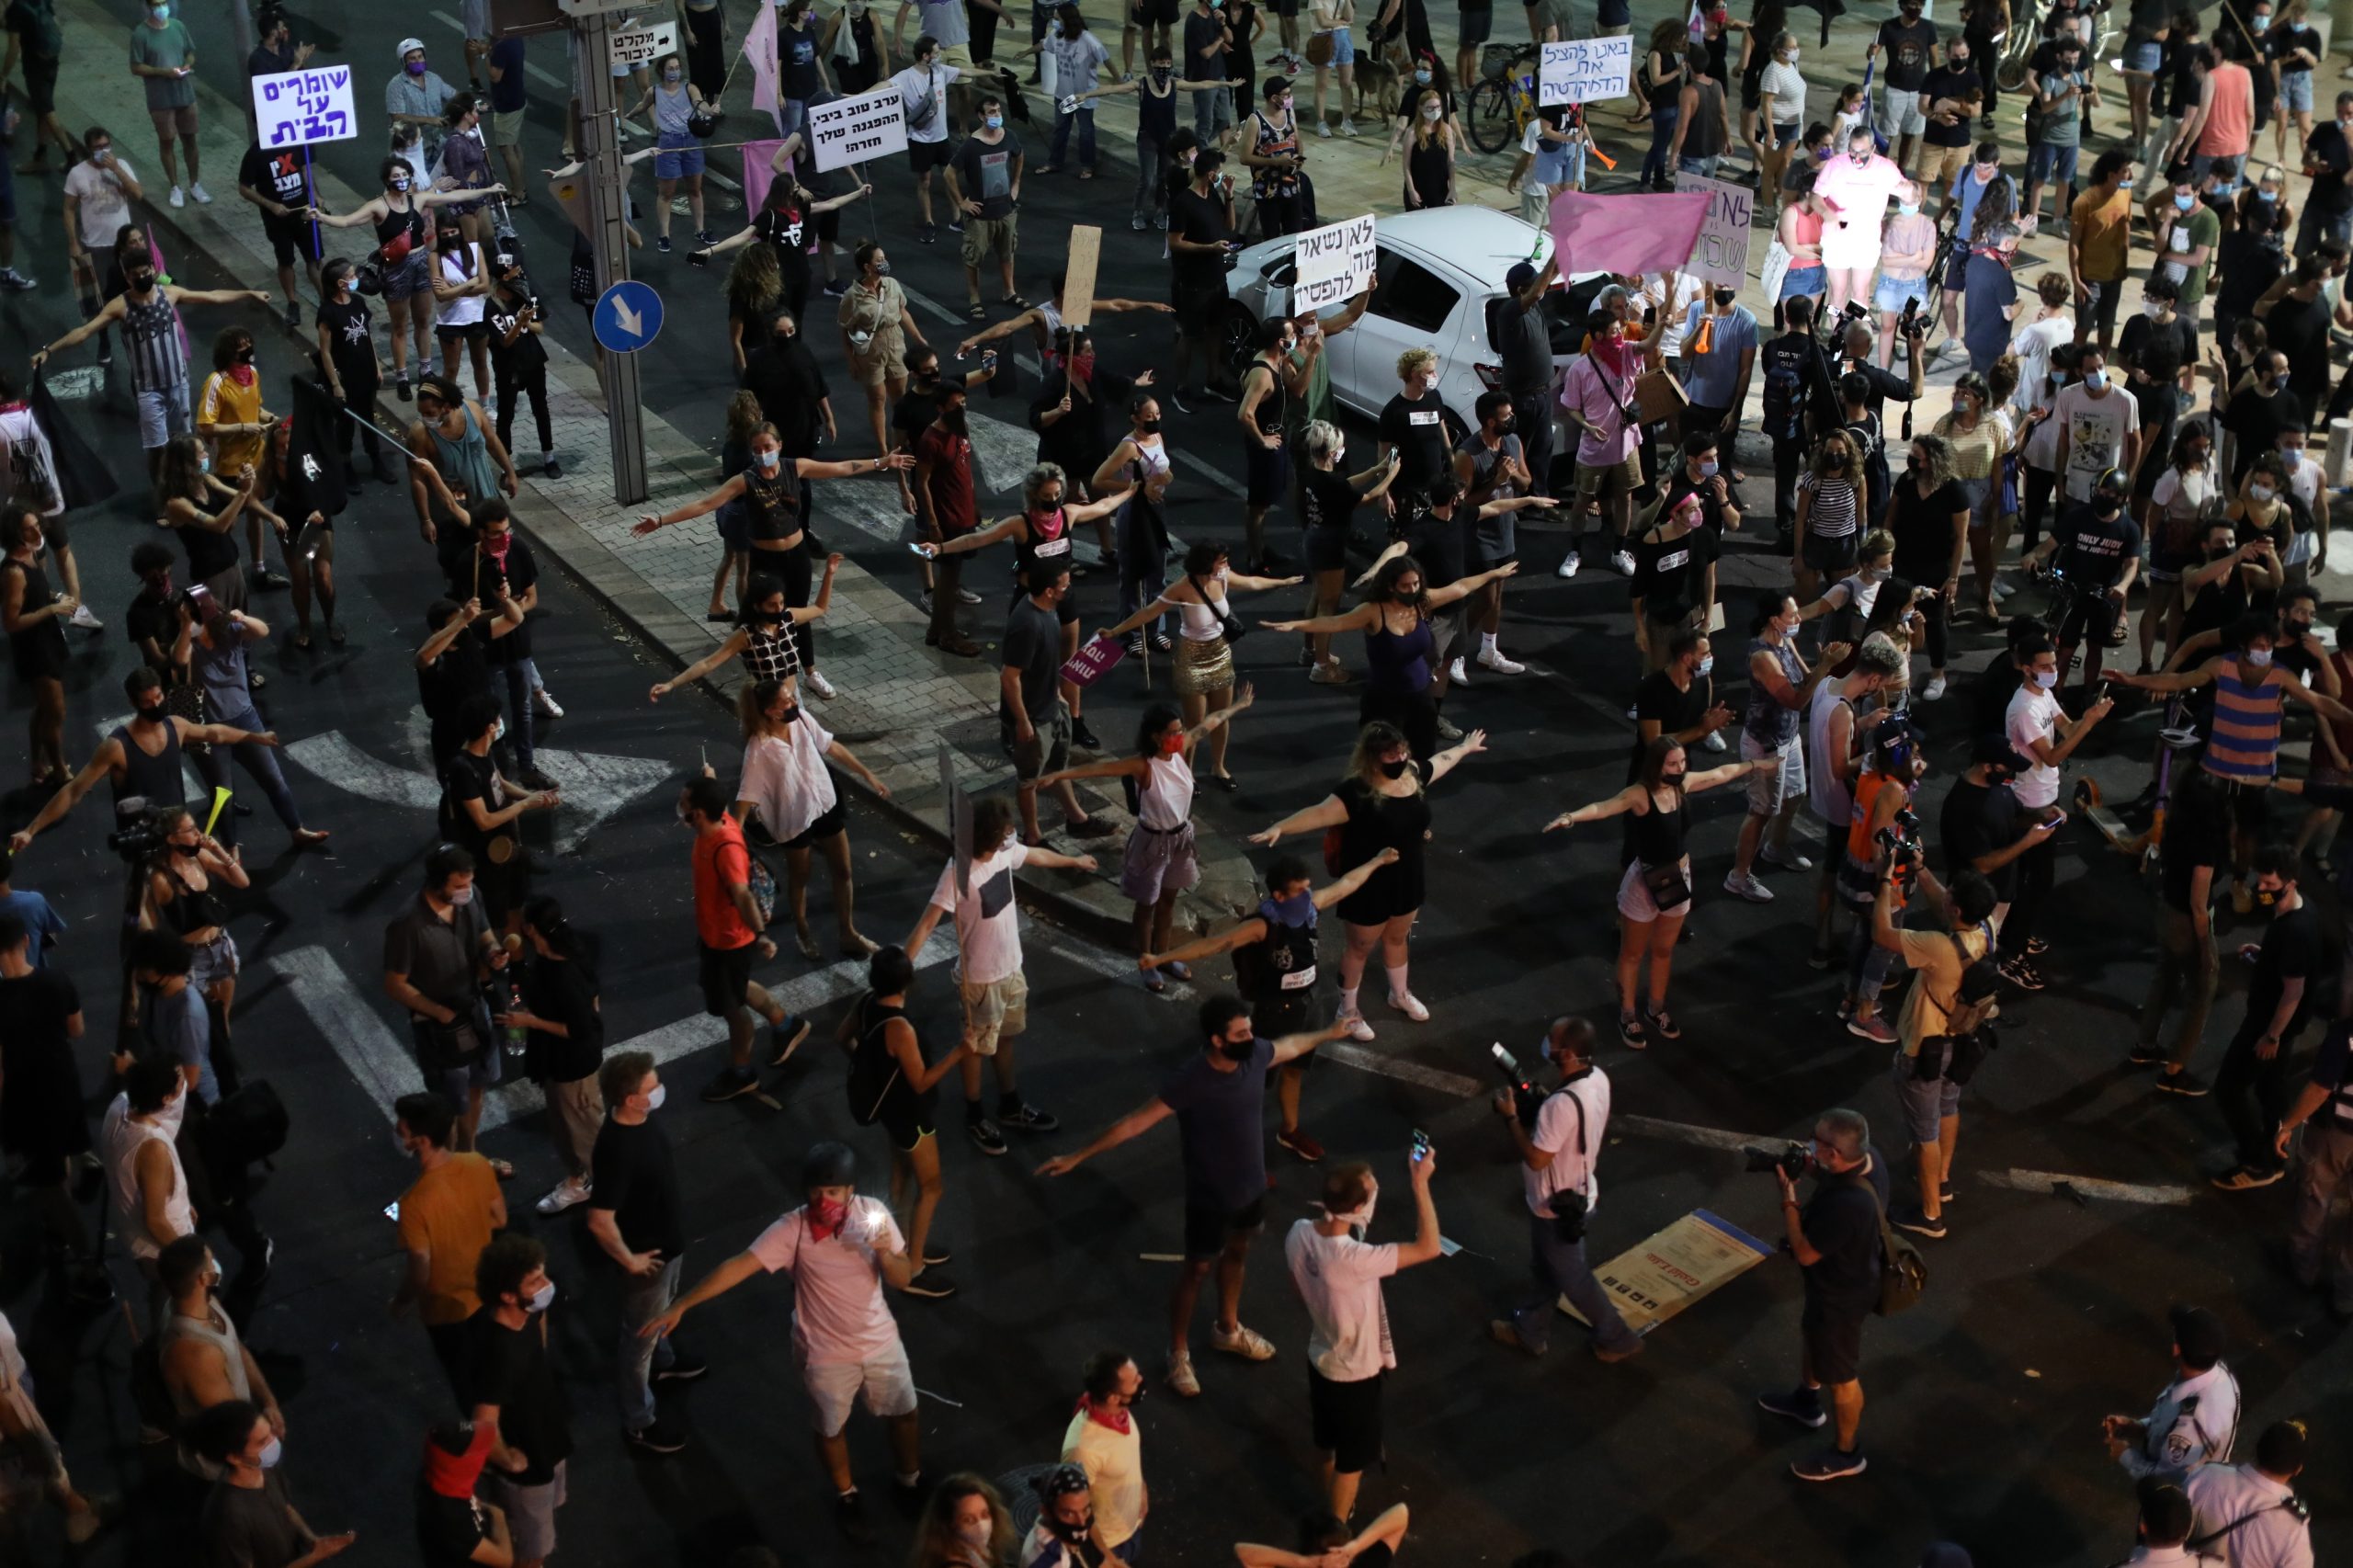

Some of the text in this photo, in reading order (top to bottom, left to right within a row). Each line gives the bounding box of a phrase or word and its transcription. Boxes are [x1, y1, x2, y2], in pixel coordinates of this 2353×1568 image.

[614, 32, 654, 48] מקלט
[614, 46, 654, 61] ציבורי
[1545, 44, 1587, 64] להציל
[1568, 61, 1603, 76] את
[263, 70, 347, 101] שומרים
[1543, 77, 1624, 98] הדמוקרטיה
[297, 95, 329, 115] על
[813, 95, 899, 128] ערב טוב ביבי,
[270, 110, 347, 145] הבית
[817, 113, 900, 144] ההפגנה שלך
[846, 137, 881, 153] חזרה!
[274, 172, 302, 192] מצב
[1722, 191, 1750, 227] לא
[1298, 229, 1343, 257] נשאר
[1353, 248, 1376, 275] מה
[1294, 270, 1354, 307] להפסיד
[2077, 533, 2123, 550] ONLY JUDY
[2077, 542, 2088, 551] CAN
